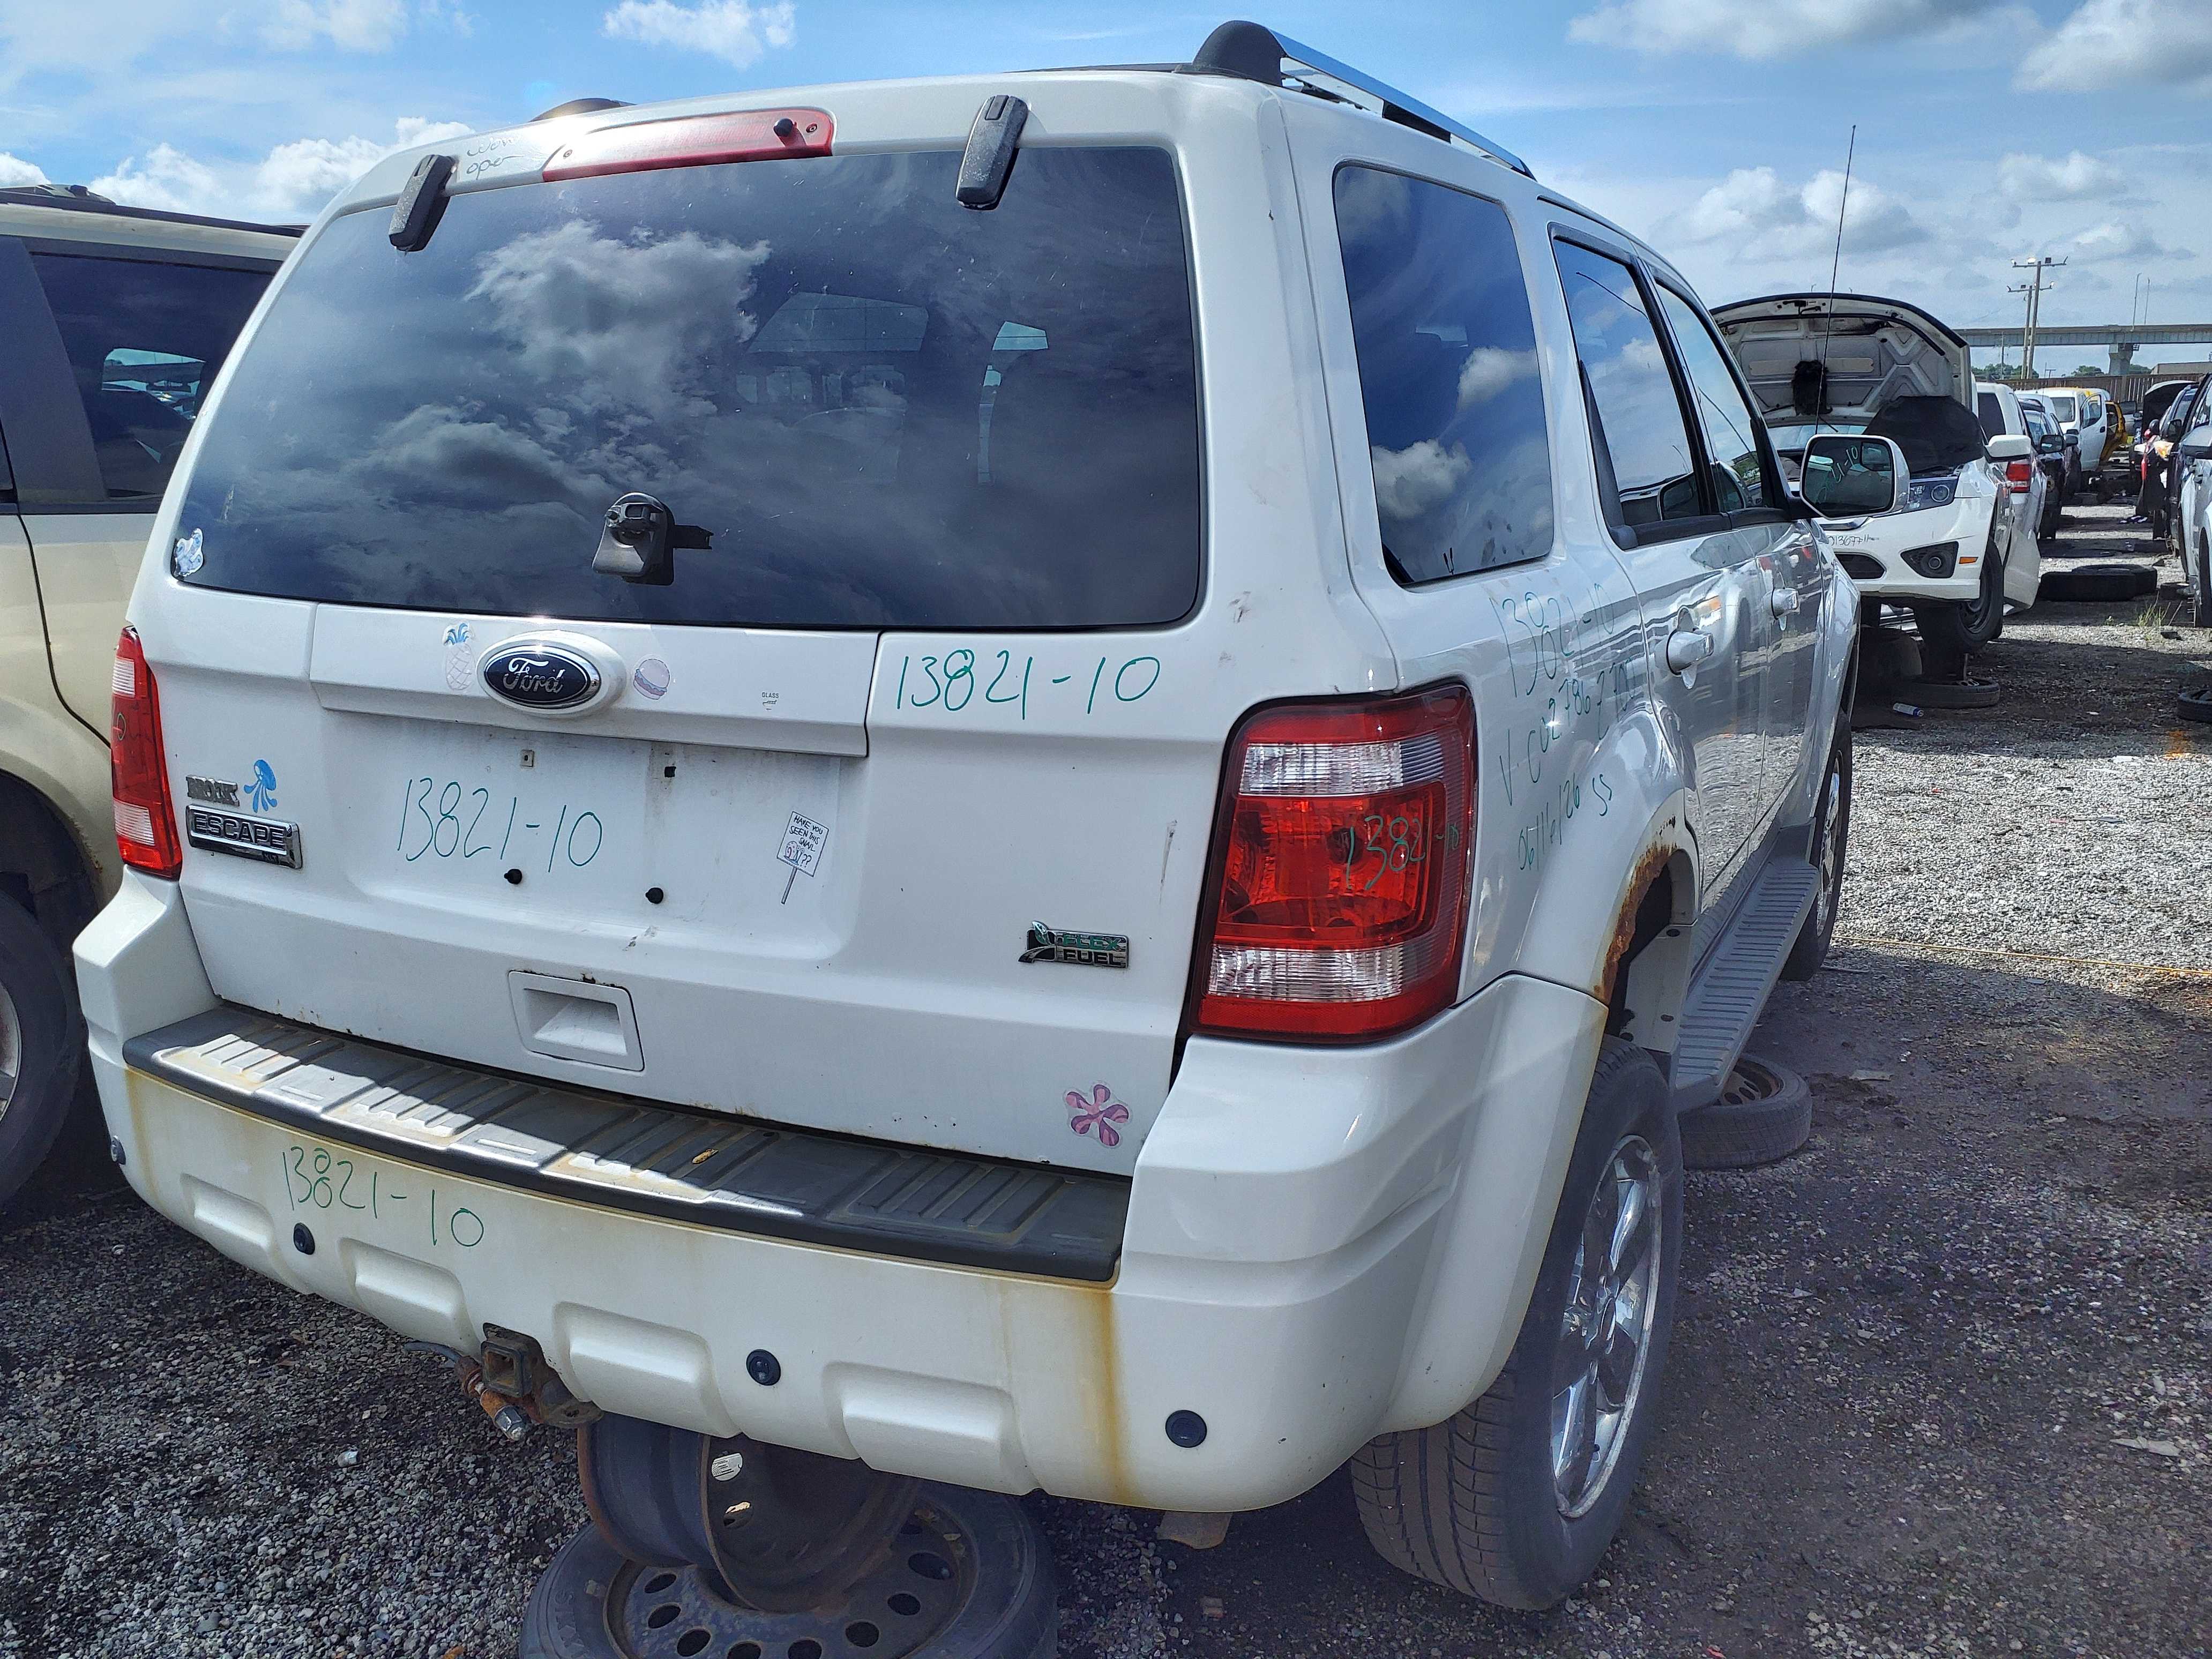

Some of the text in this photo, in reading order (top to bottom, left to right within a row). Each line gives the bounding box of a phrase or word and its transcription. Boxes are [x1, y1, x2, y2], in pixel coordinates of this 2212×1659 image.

[503, 657, 566, 693] Ford
[896, 649, 1161, 720] 13821-10
[193, 811, 287, 851] ESCAPE
[397, 776, 603, 873] 13821-10
[789, 825, 820, 845] SEEN THIS
[793, 814, 823, 835] HAVE YOU
[798, 837, 816, 852] SNAIL
[1063, 933, 1120, 951] FLEX
[1063, 948, 1122, 965] FUEL
[282, 1146, 484, 1247] 13821-10
